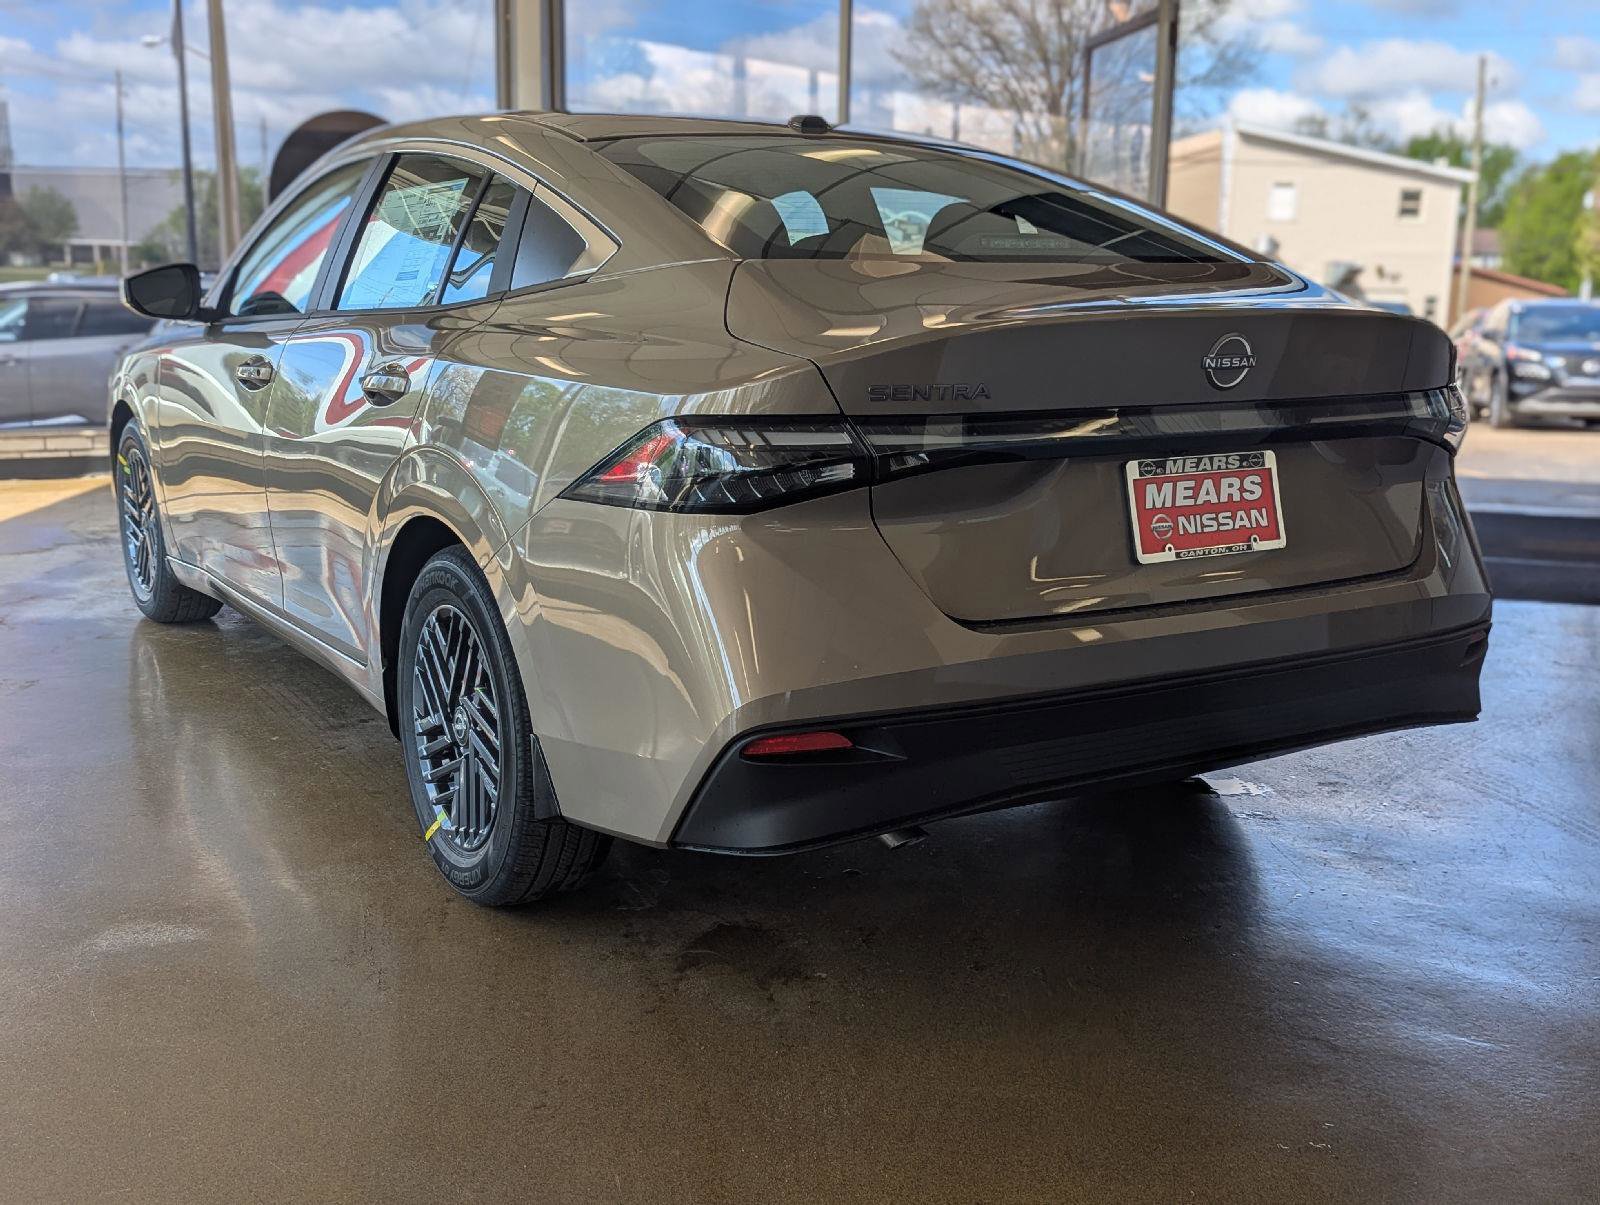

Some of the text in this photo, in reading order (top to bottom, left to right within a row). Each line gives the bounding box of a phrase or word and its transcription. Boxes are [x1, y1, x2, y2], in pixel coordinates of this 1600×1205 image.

[1203, 356, 1257, 368] NISSAN
[867, 383, 991, 401] SENTRA
[1165, 455, 1240, 475] MEARS
[1145, 475, 1263, 510] MEARS
[1177, 508, 1269, 535] NISSAN
